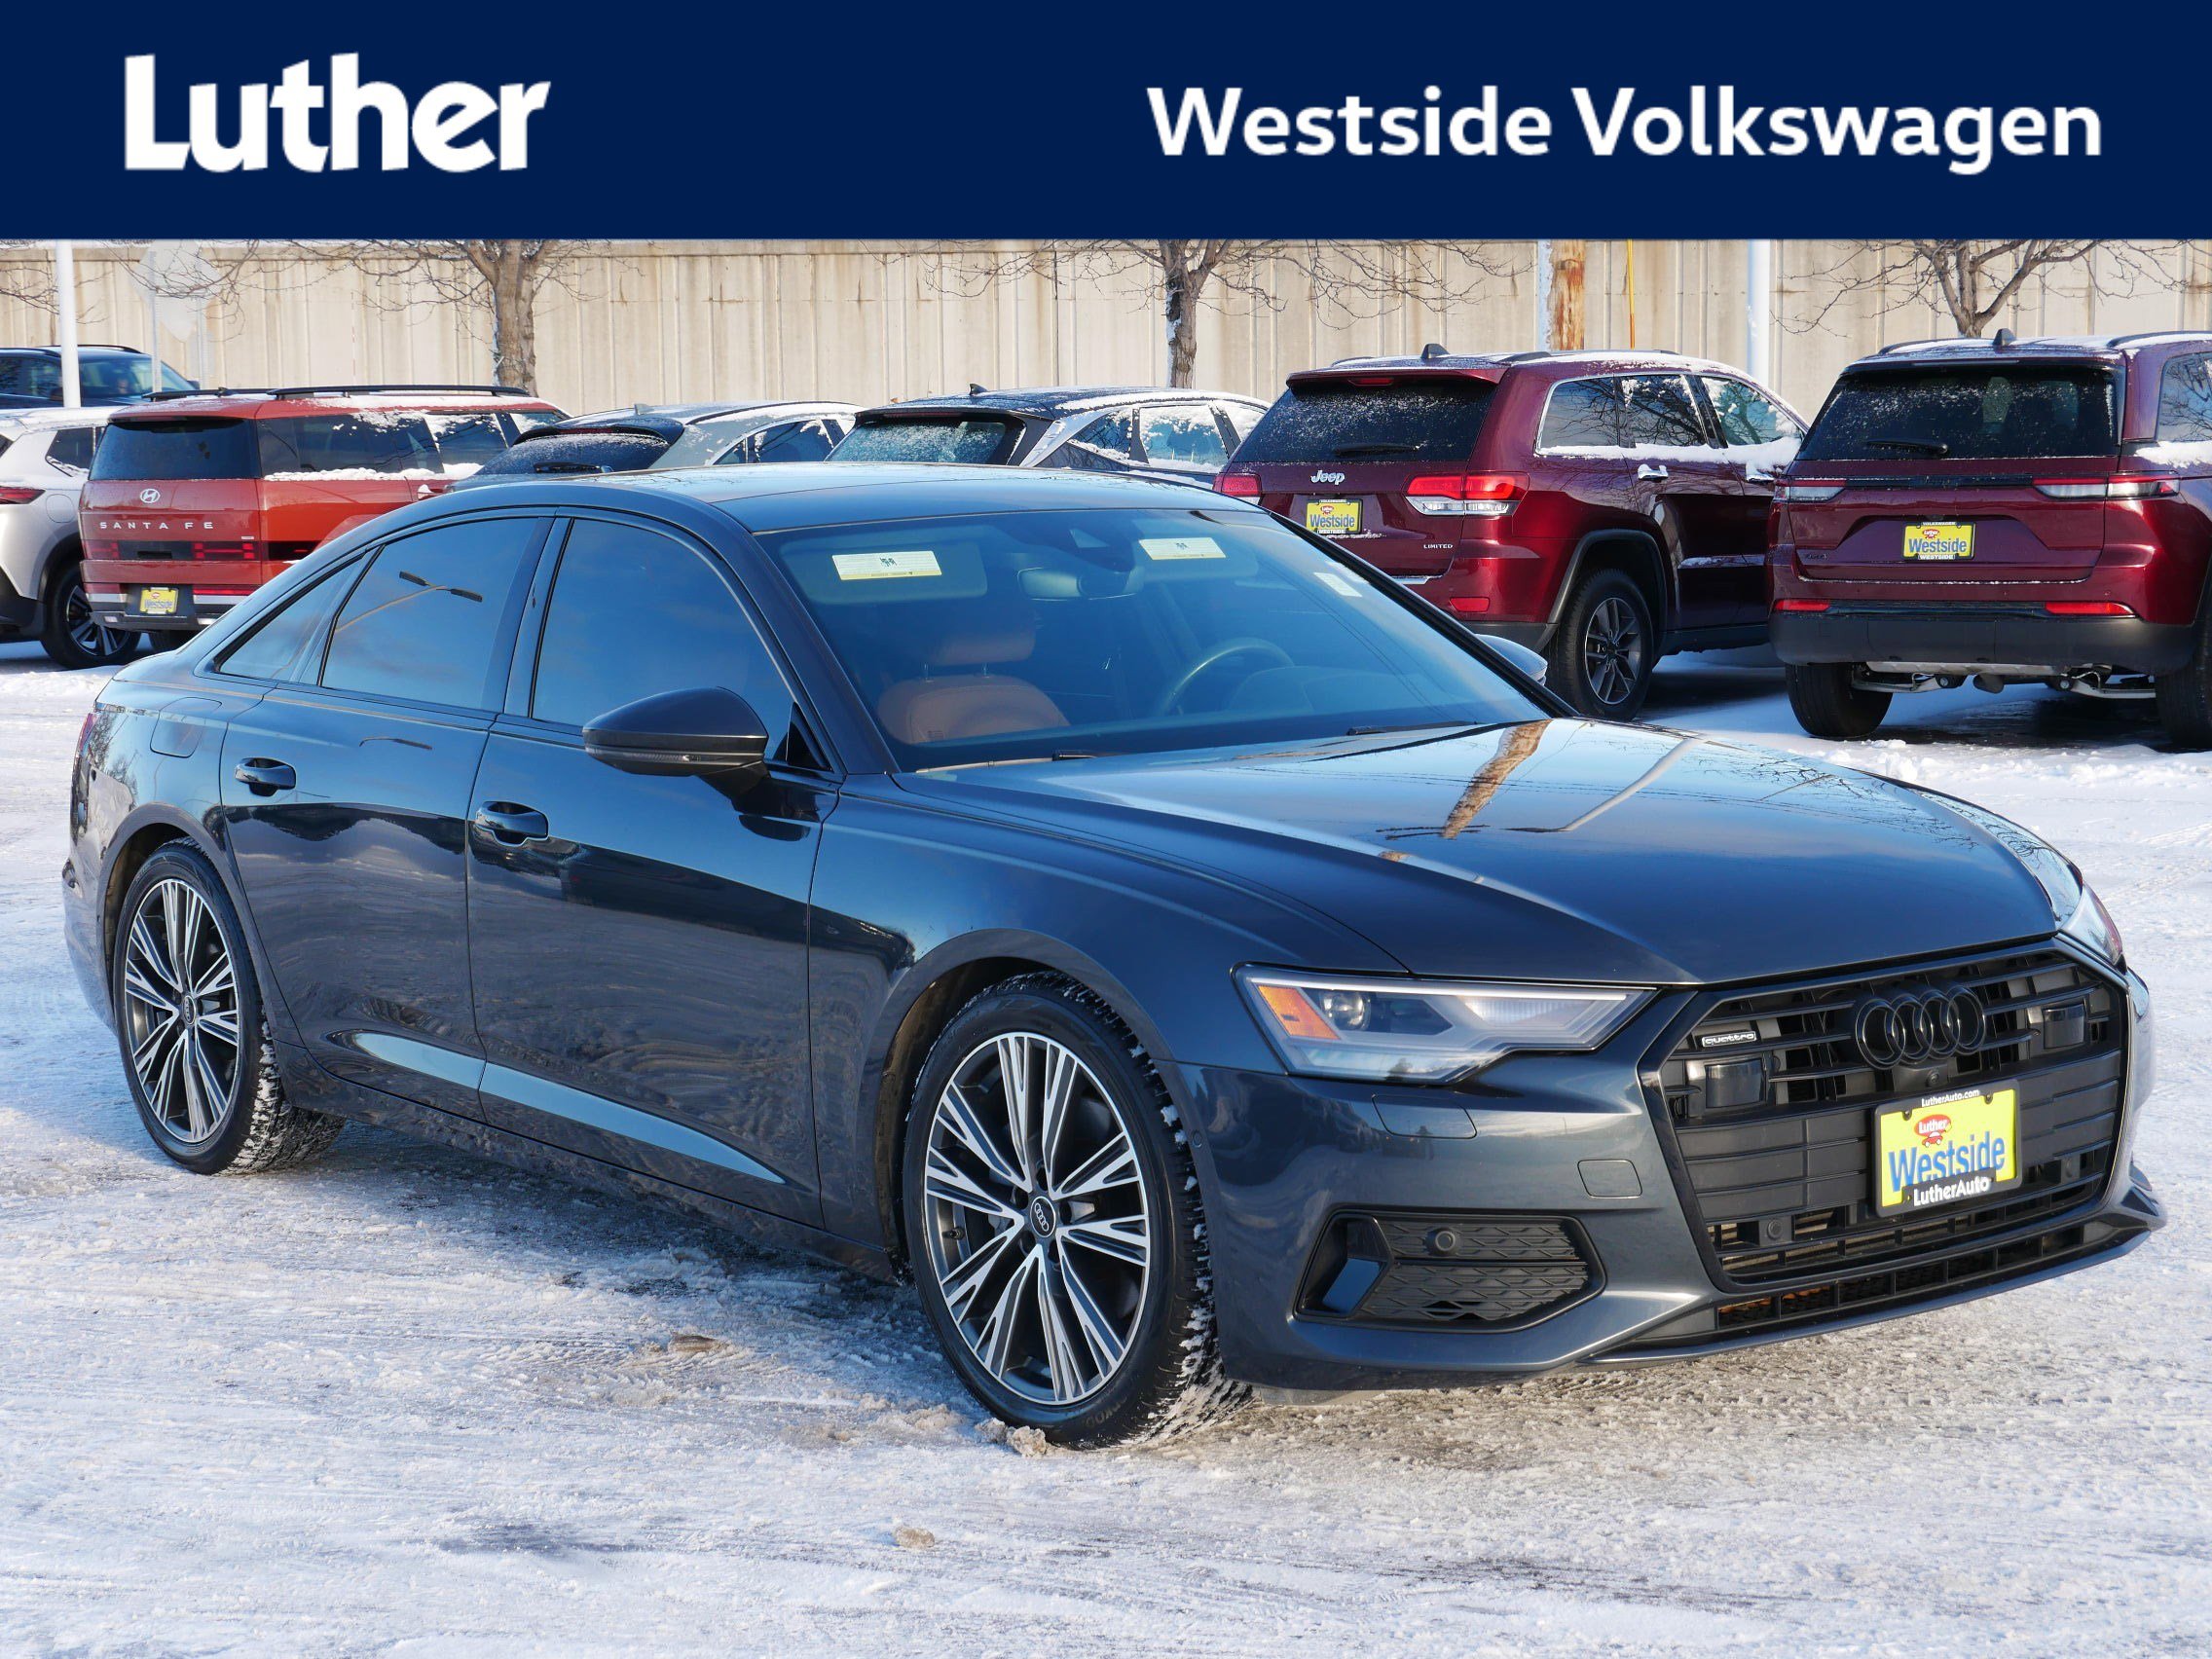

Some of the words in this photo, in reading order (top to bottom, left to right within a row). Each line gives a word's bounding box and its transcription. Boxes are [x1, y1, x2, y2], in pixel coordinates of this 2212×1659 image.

[1309, 469, 1346, 485] Jeep
[1309, 514, 1355, 528] Westside
[1908, 537, 1968, 553] Westside
[1705, 1033, 1754, 1046] quattro
[1921, 1088, 1980, 1108] LutherAuto.com
[1918, 1119, 1948, 1134] Luther
[1888, 1130, 2006, 1194] Westside
[1913, 1176, 1990, 1207] LutherAuto
